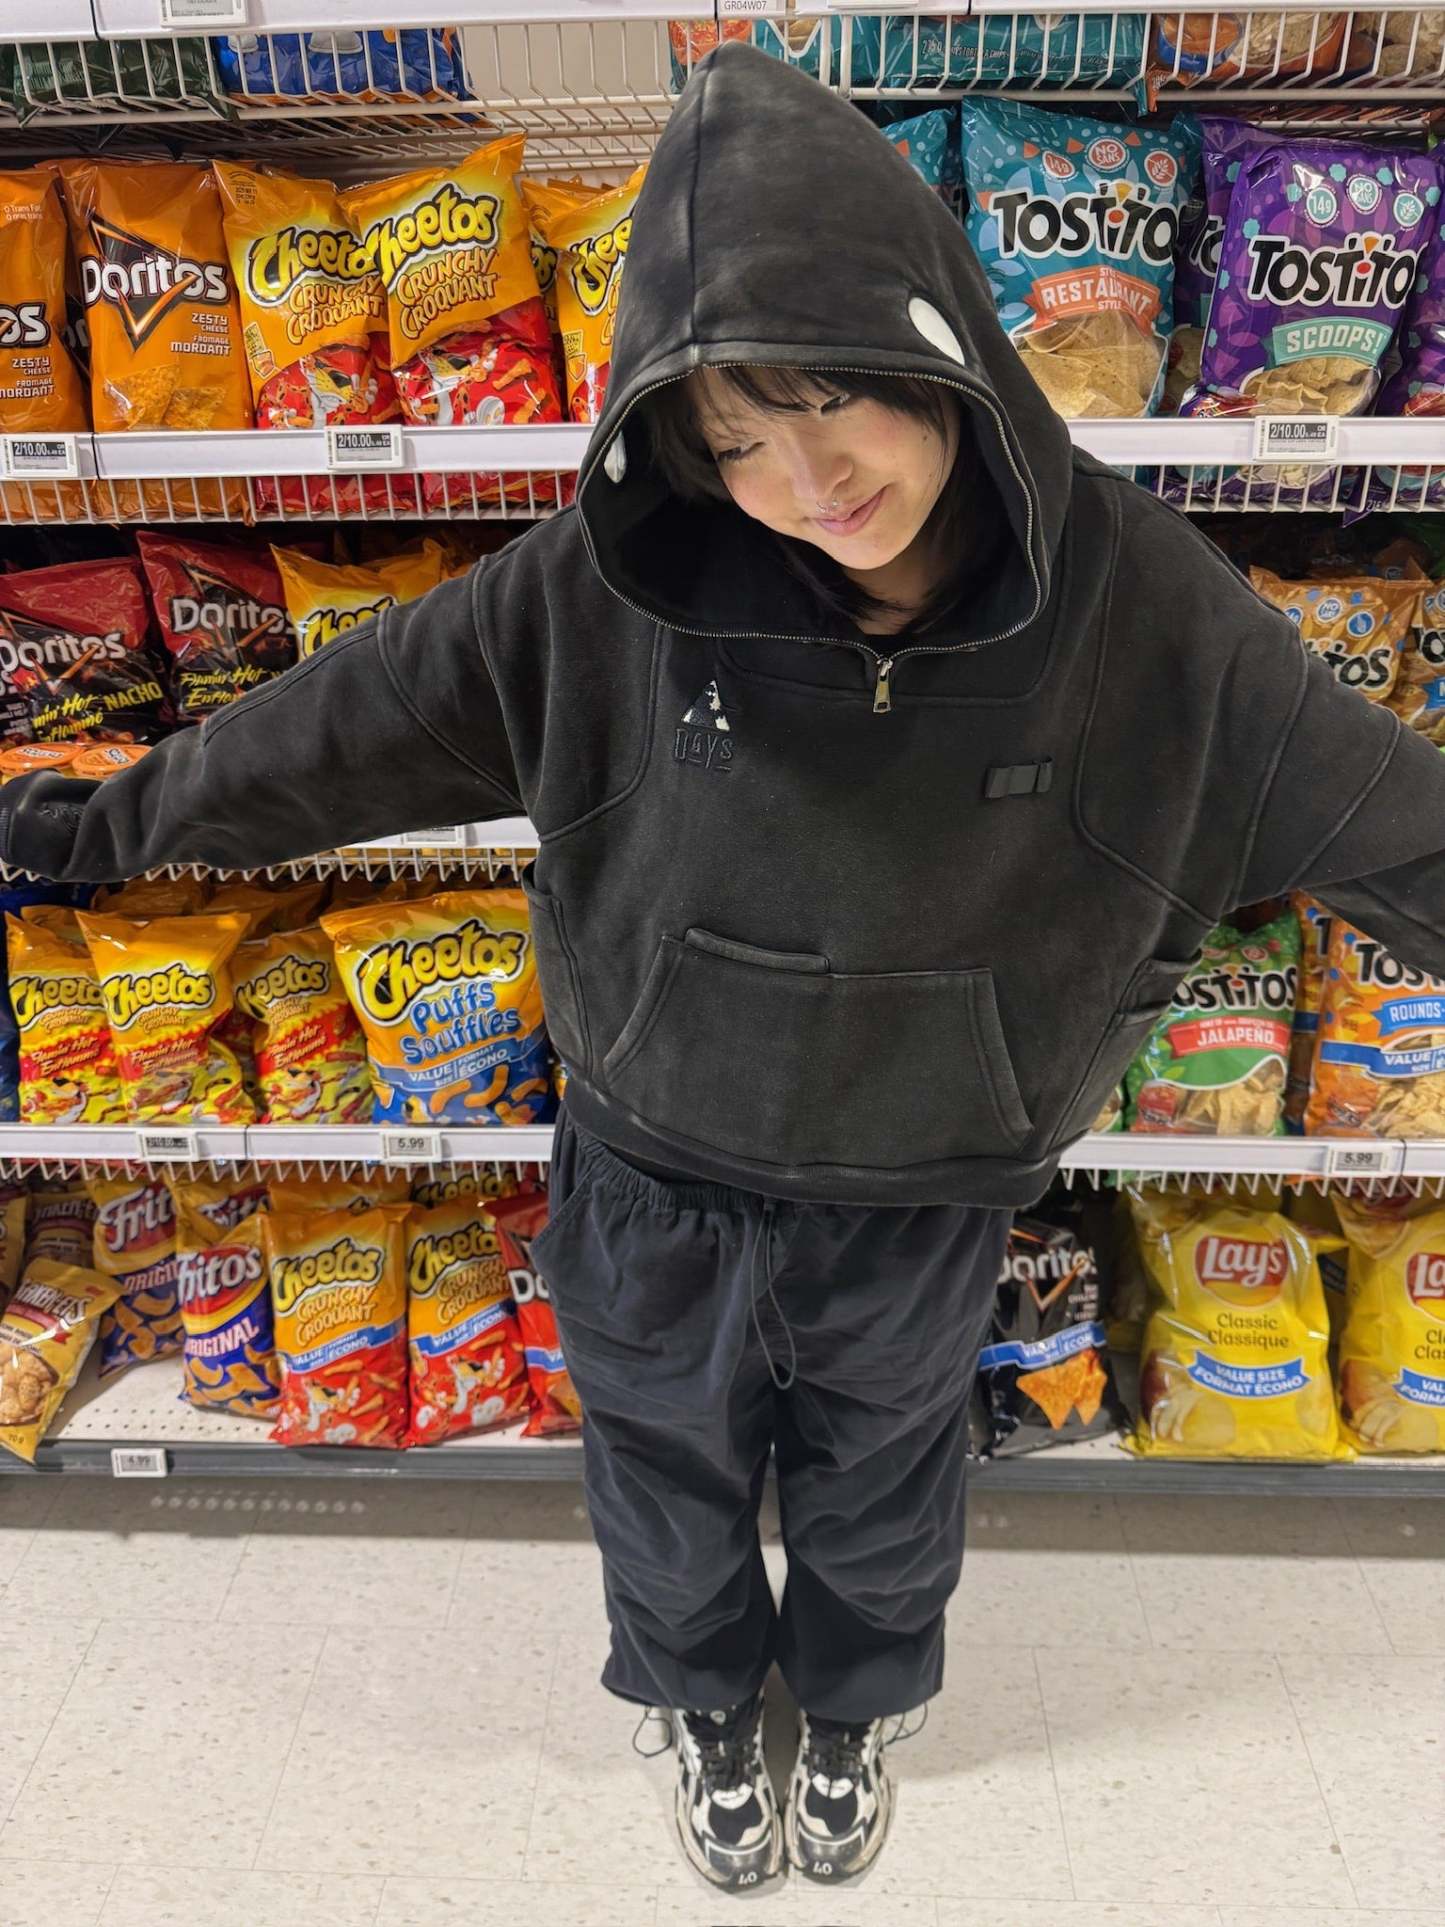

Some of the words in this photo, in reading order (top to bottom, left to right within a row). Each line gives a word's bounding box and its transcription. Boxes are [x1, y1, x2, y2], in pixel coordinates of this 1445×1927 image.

[1096, 143, 1119, 154] NO
[993, 183, 1179, 263] TOSTiTO
[249, 226, 375, 303] Cheeto
[397, 246, 498, 304] CRUNCHY
[1251, 237, 1417, 305] TOSTiTO
[81, 255, 229, 305] Doritos
[289, 275, 381, 314] CRUNCHY
[400, 273, 499, 338] CROQUANT
[1098, 300, 1121, 310] STYLE
[192, 312, 228, 325] ZESTY
[201, 324, 229, 333] CHEESE
[287, 295, 384, 344] CROQUANT
[193, 335, 230, 346] FROMAGE
[1287, 325, 1384, 355] SCOOPS!
[12, 357, 51, 369] ZESTY
[23, 367, 52, 376] CHEESE
[16, 377, 53, 388] FROMAGE
[338, 434, 372, 447] 2/10.00
[1270, 424, 1306, 438] 2/10.00
[14, 443, 47, 456] 2/10.00
[0, 632, 126, 673] Doritos
[231, 664, 267, 685] Hot
[61, 693, 98, 716] Hot
[102, 681, 164, 711] NACHO
[355, 920, 528, 1023] Cheetos
[102, 963, 213, 1027] Cheetos
[237, 955, 326, 1019] Cheetos
[9, 976, 102, 1026] Cheeto
[72, 1036, 97, 1051] Hot
[171, 1038, 196, 1052] Hot
[1197, 1026, 1275, 1047] JALAPEÑO
[1384, 1050, 1432, 1067] VALUE
[407, 1063, 453, 1082] VALUE
[398, 1137, 425, 1149] 5.99
[1344, 1152, 1373, 1164] 5.99
[99, 1186, 172, 1251] Frit
[409, 1221, 501, 1294] Cheeto
[1201, 1237, 1286, 1288] Lay's
[271, 1239, 380, 1313] Cheetos
[296, 1286, 375, 1322] CRUNCHY
[296, 1303, 376, 1347] CROQUANT
[1216, 1312, 1279, 1329] Classic
[432, 1323, 467, 1347] VALUE
[1208, 1329, 1290, 1350] Classique
[1194, 1366, 1251, 1394] FORMAT
[1216, 1364, 1256, 1383] VALUE
[1257, 1367, 1286, 1382] SIZE
